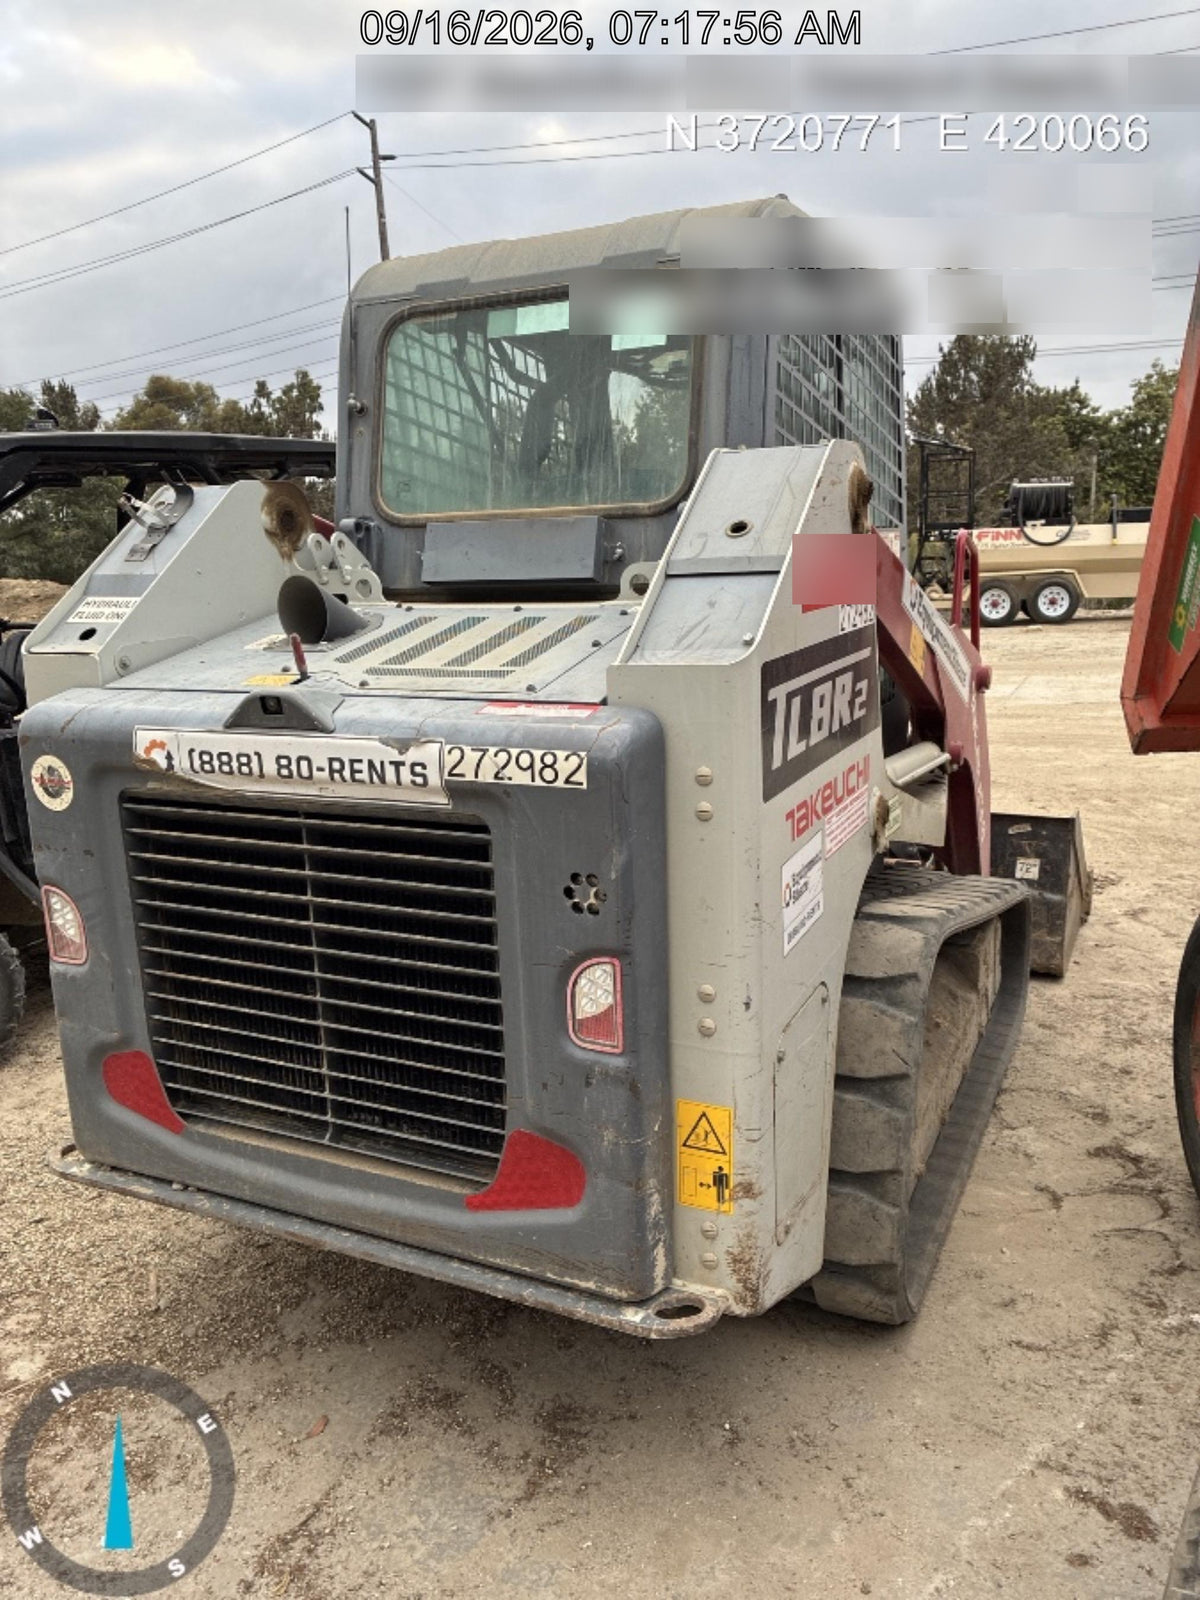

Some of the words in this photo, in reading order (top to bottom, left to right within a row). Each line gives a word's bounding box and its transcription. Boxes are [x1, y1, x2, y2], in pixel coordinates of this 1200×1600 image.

[188, 747, 265, 779] (888)
[275, 753, 430, 788] 80-RENTS
[446, 745, 586, 787] 272982
